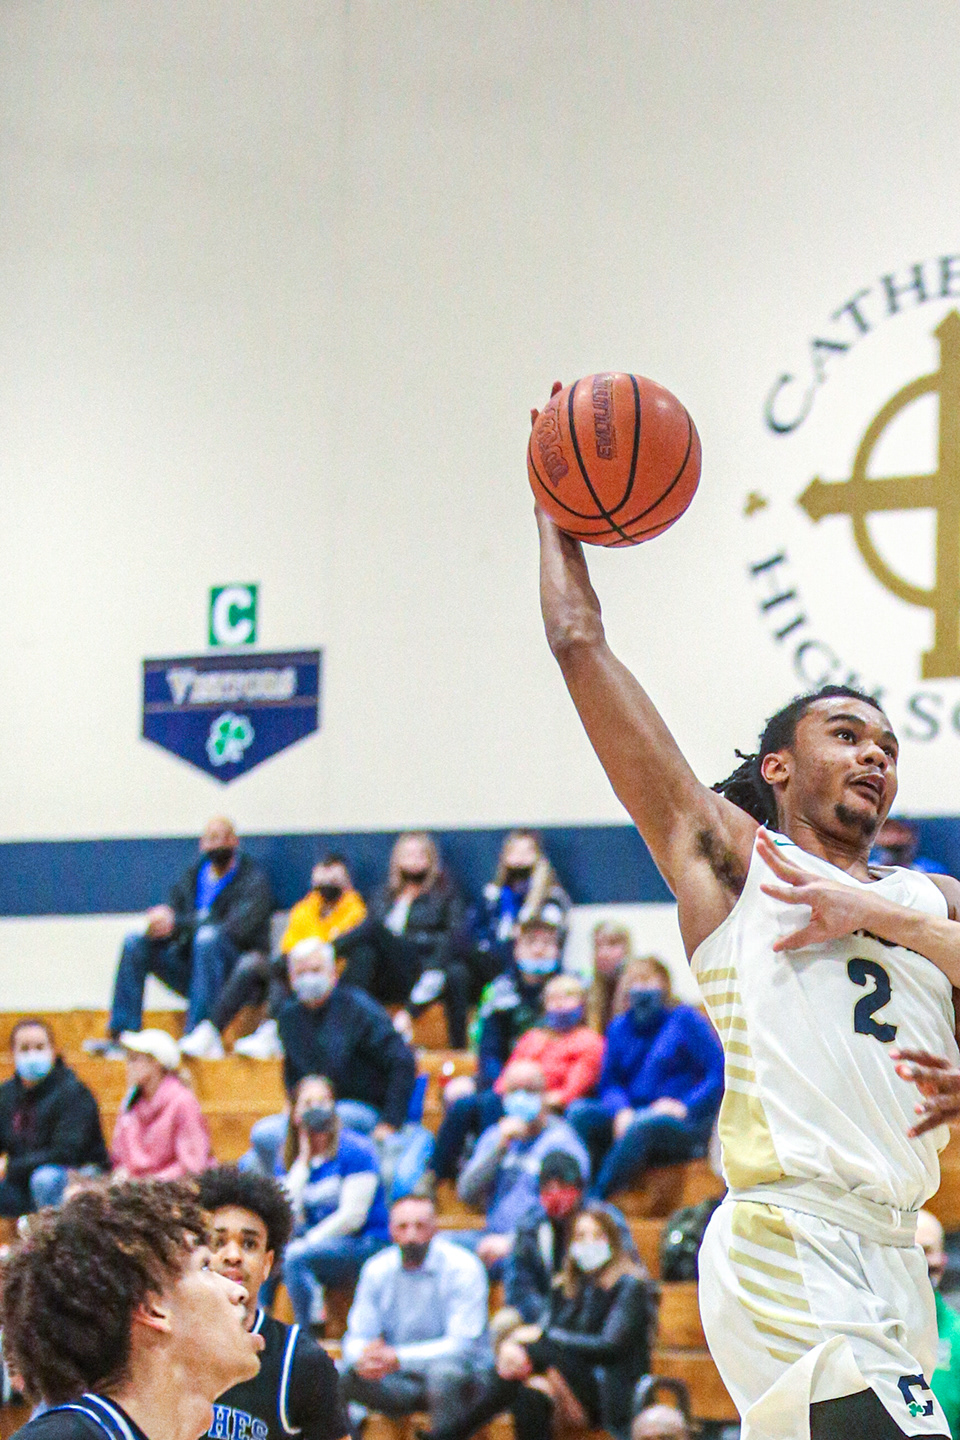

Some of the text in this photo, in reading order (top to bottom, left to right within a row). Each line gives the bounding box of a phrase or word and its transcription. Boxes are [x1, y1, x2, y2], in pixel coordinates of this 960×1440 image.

[213, 586, 254, 644] C
[748, 549, 884, 700] HIG
[846, 957, 898, 1043] 2
